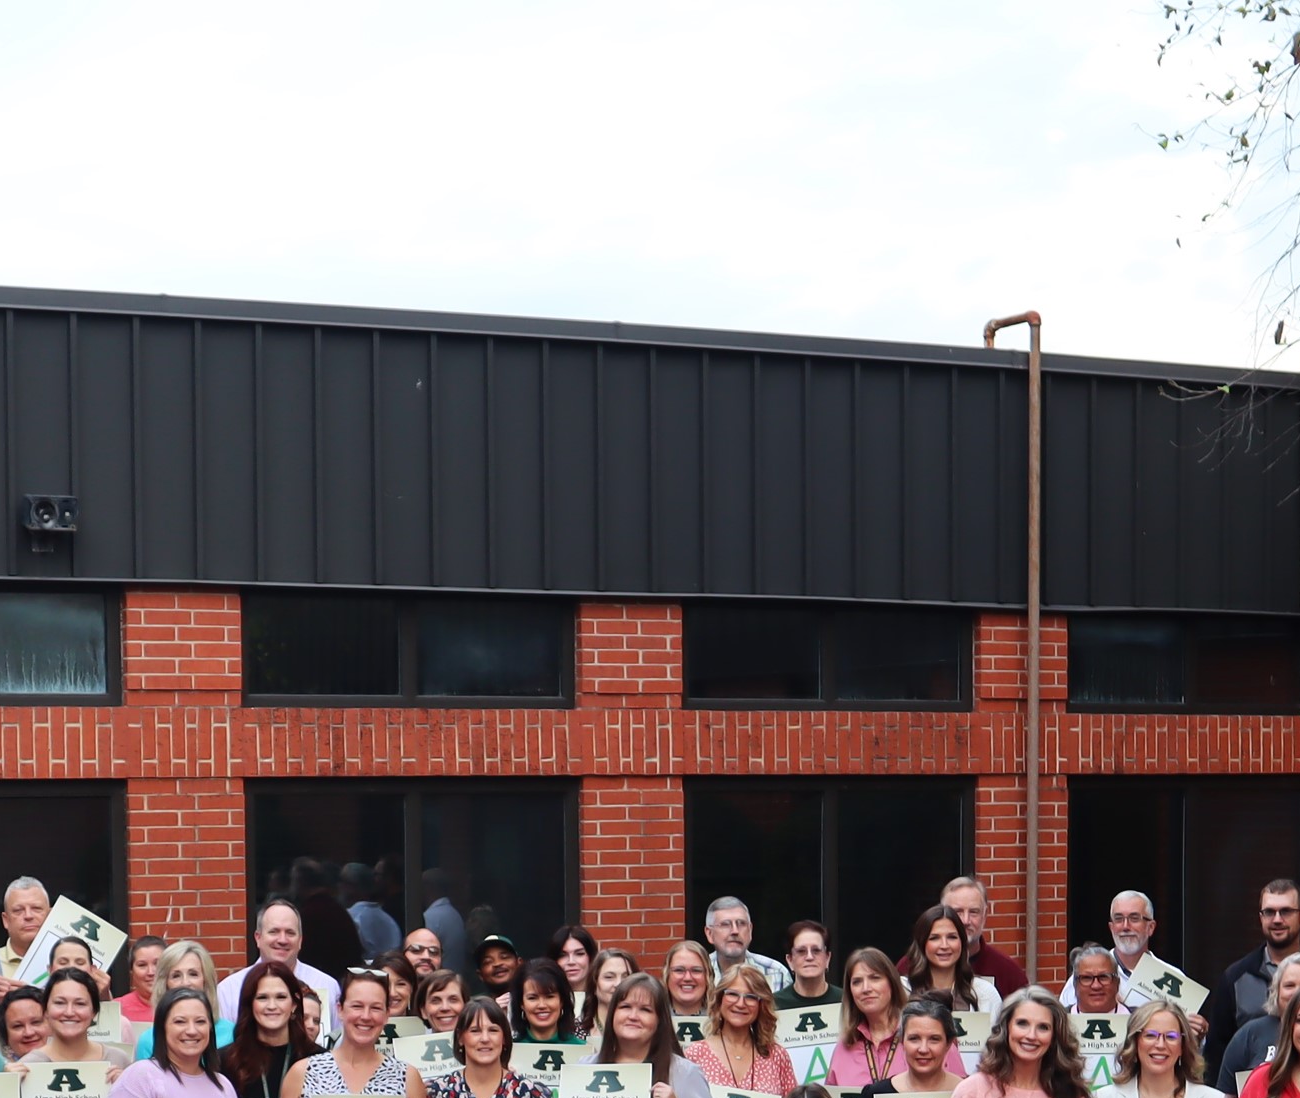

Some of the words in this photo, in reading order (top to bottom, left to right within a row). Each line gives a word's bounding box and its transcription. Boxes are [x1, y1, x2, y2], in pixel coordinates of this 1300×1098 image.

[795, 1012, 828, 1033] A
[802, 1034, 817, 1042] High
[47, 1068, 86, 1092] A
[585, 1068, 624, 1092] A
